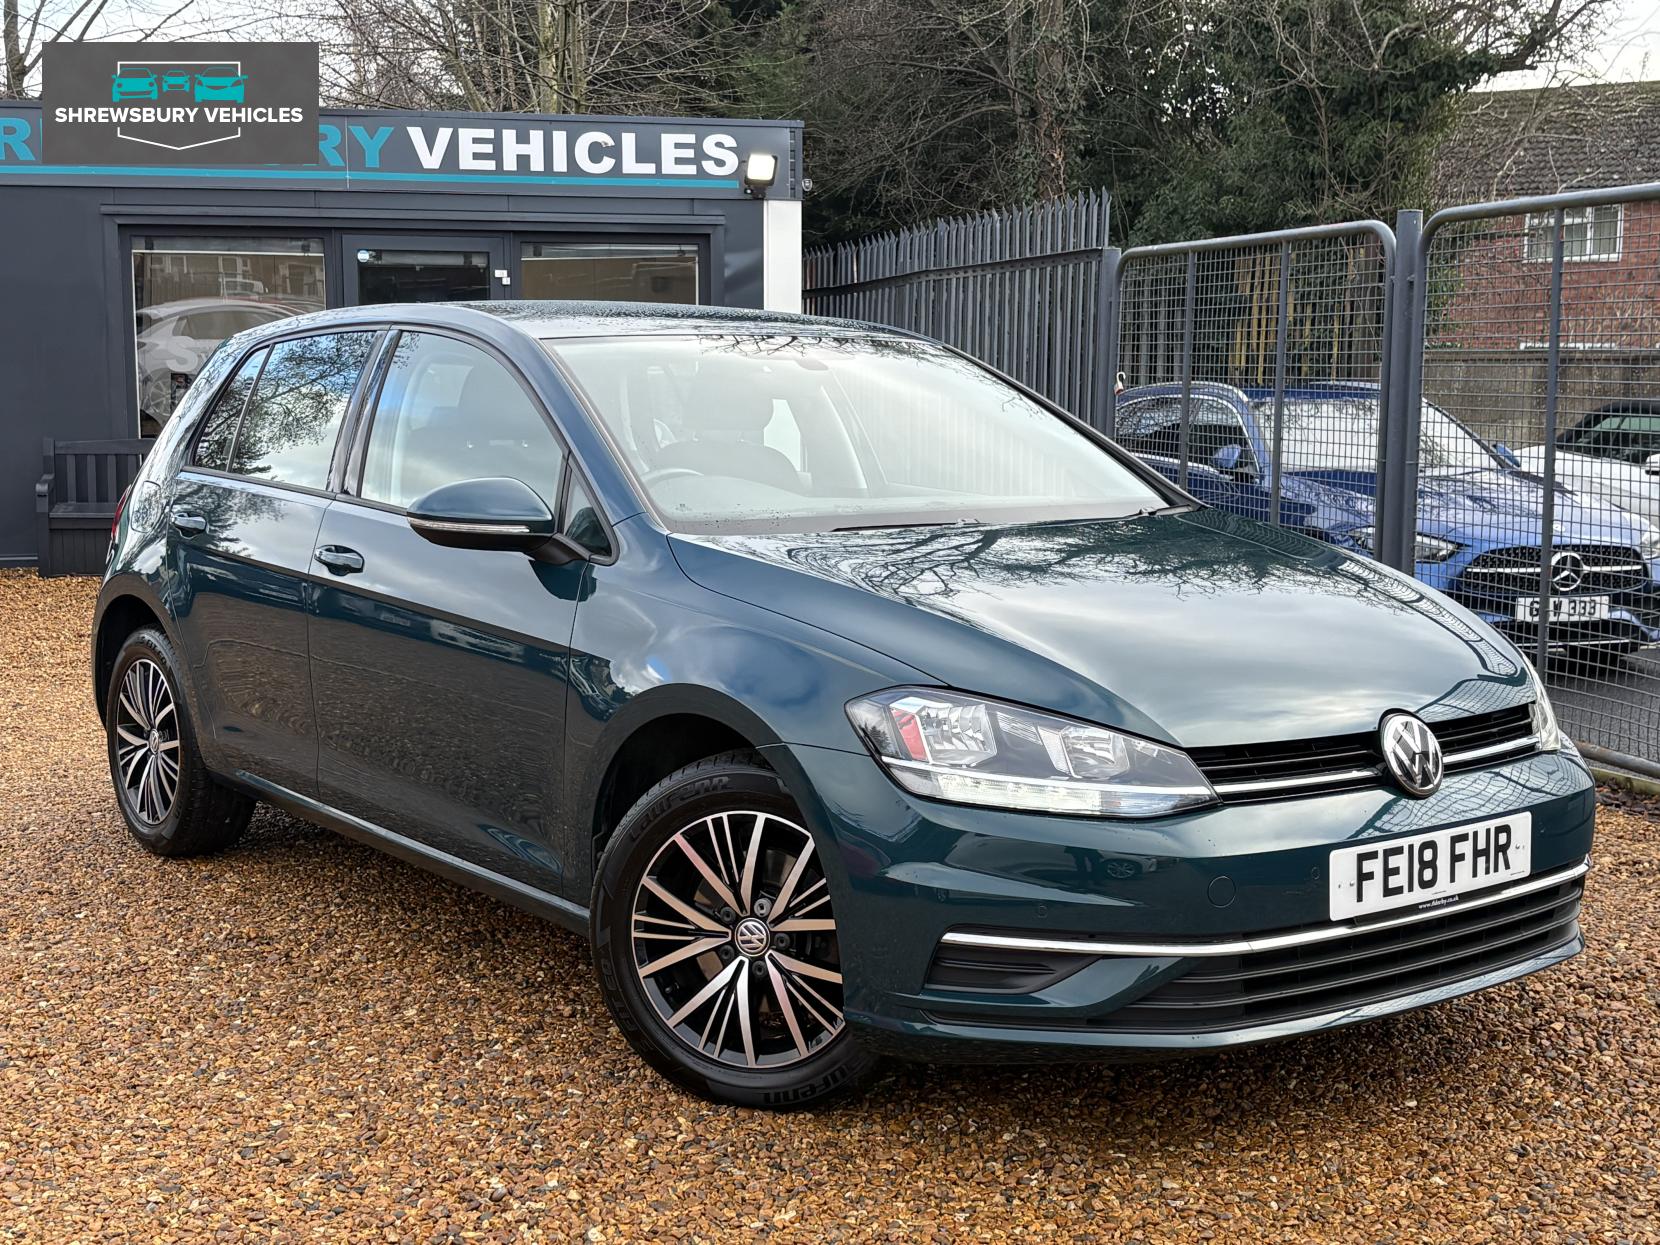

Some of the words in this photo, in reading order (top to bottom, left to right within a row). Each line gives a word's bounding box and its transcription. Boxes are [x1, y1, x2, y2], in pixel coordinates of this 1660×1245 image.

[406, 126, 739, 176] VEHICLES
[1356, 839, 1439, 903] FE18
[1450, 824, 1512, 884] FHR
